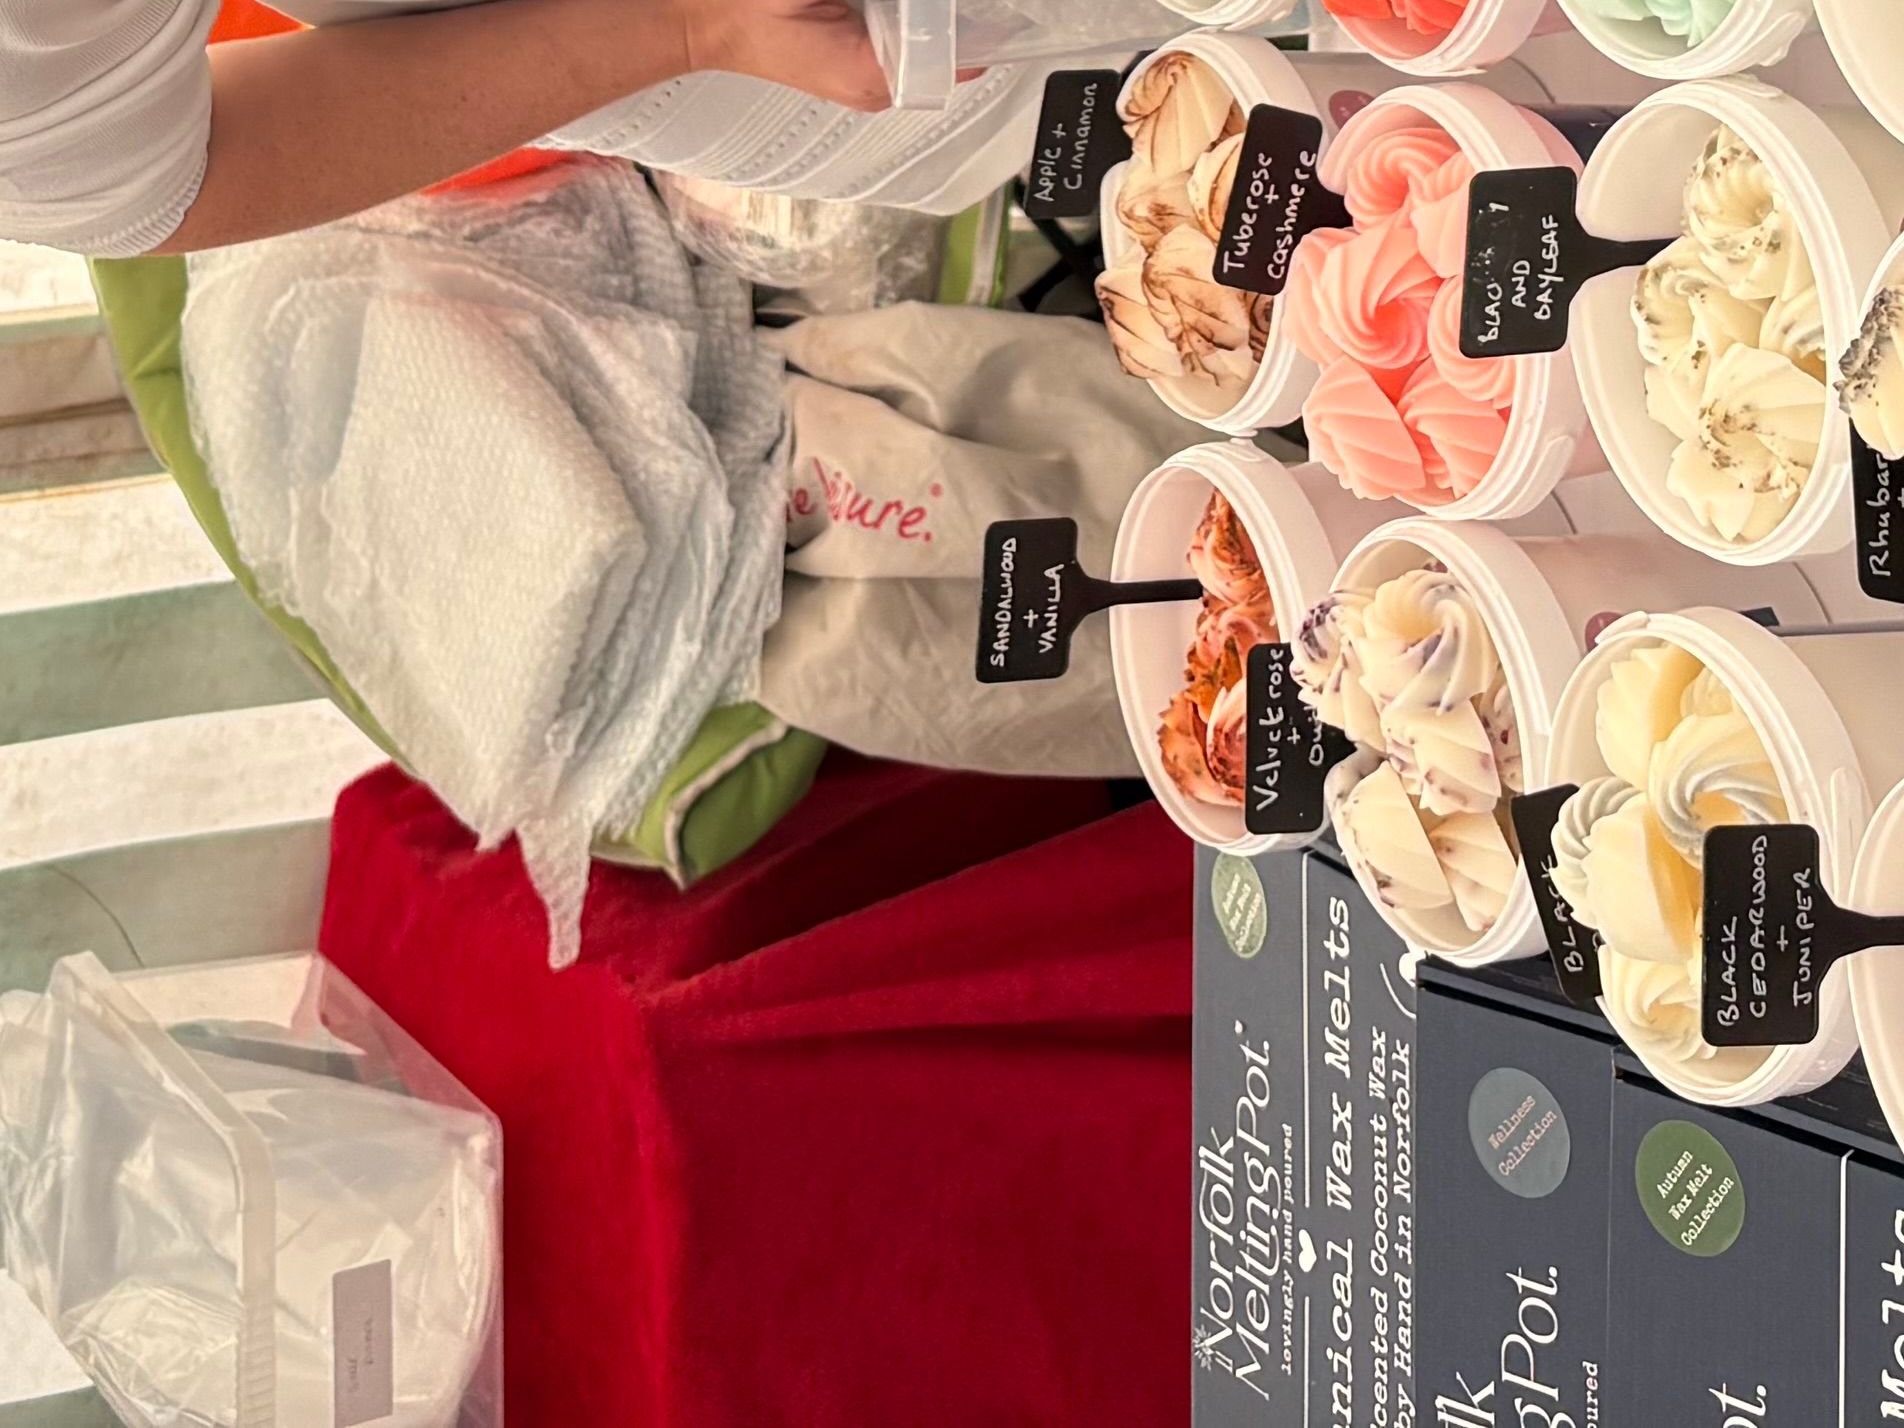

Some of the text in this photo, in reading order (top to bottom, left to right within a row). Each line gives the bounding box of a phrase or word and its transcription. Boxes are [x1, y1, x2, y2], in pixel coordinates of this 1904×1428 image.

[1033, 146, 1063, 203] Apple
[1063, 82, 1098, 190] Cinnamon
[1222, 152, 1274, 274] Tuberose
[1512, 260, 1532, 307] AND
[1534, 214, 1563, 320] BAYLEAF
[1866, 442, 1892, 576] Rhubar
[1038, 564, 1064, 653] VANILLA
[1254, 647, 1285, 811] Velvet rose
[1717, 916, 1739, 1026] BLACK
[1749, 834, 1768, 1018] CEDARWOOD
[1793, 867, 1815, 1007] JUNIPER
[1369, 1026, 1387, 1098] Wax
[1281, 1123, 1295, 1204] poured
[1323, 896, 1354, 1428] nical Wax Melts
[1392, 1038, 1412, 1196] Norfolk
[1369, 1114, 1389, 1276] Coconut
[1656, 1150, 1694, 1199] Autumn
[1667, 1162, 1714, 1220] Wax Melt
[1680, 1176, 1736, 1246] Collection
[1196, 1126, 1236, 1373] Norfolk
[1280, 1208, 1294, 1264] hand
[1394, 1214, 1412, 1258] in
[1393, 1272, 1412, 1377] Hand
